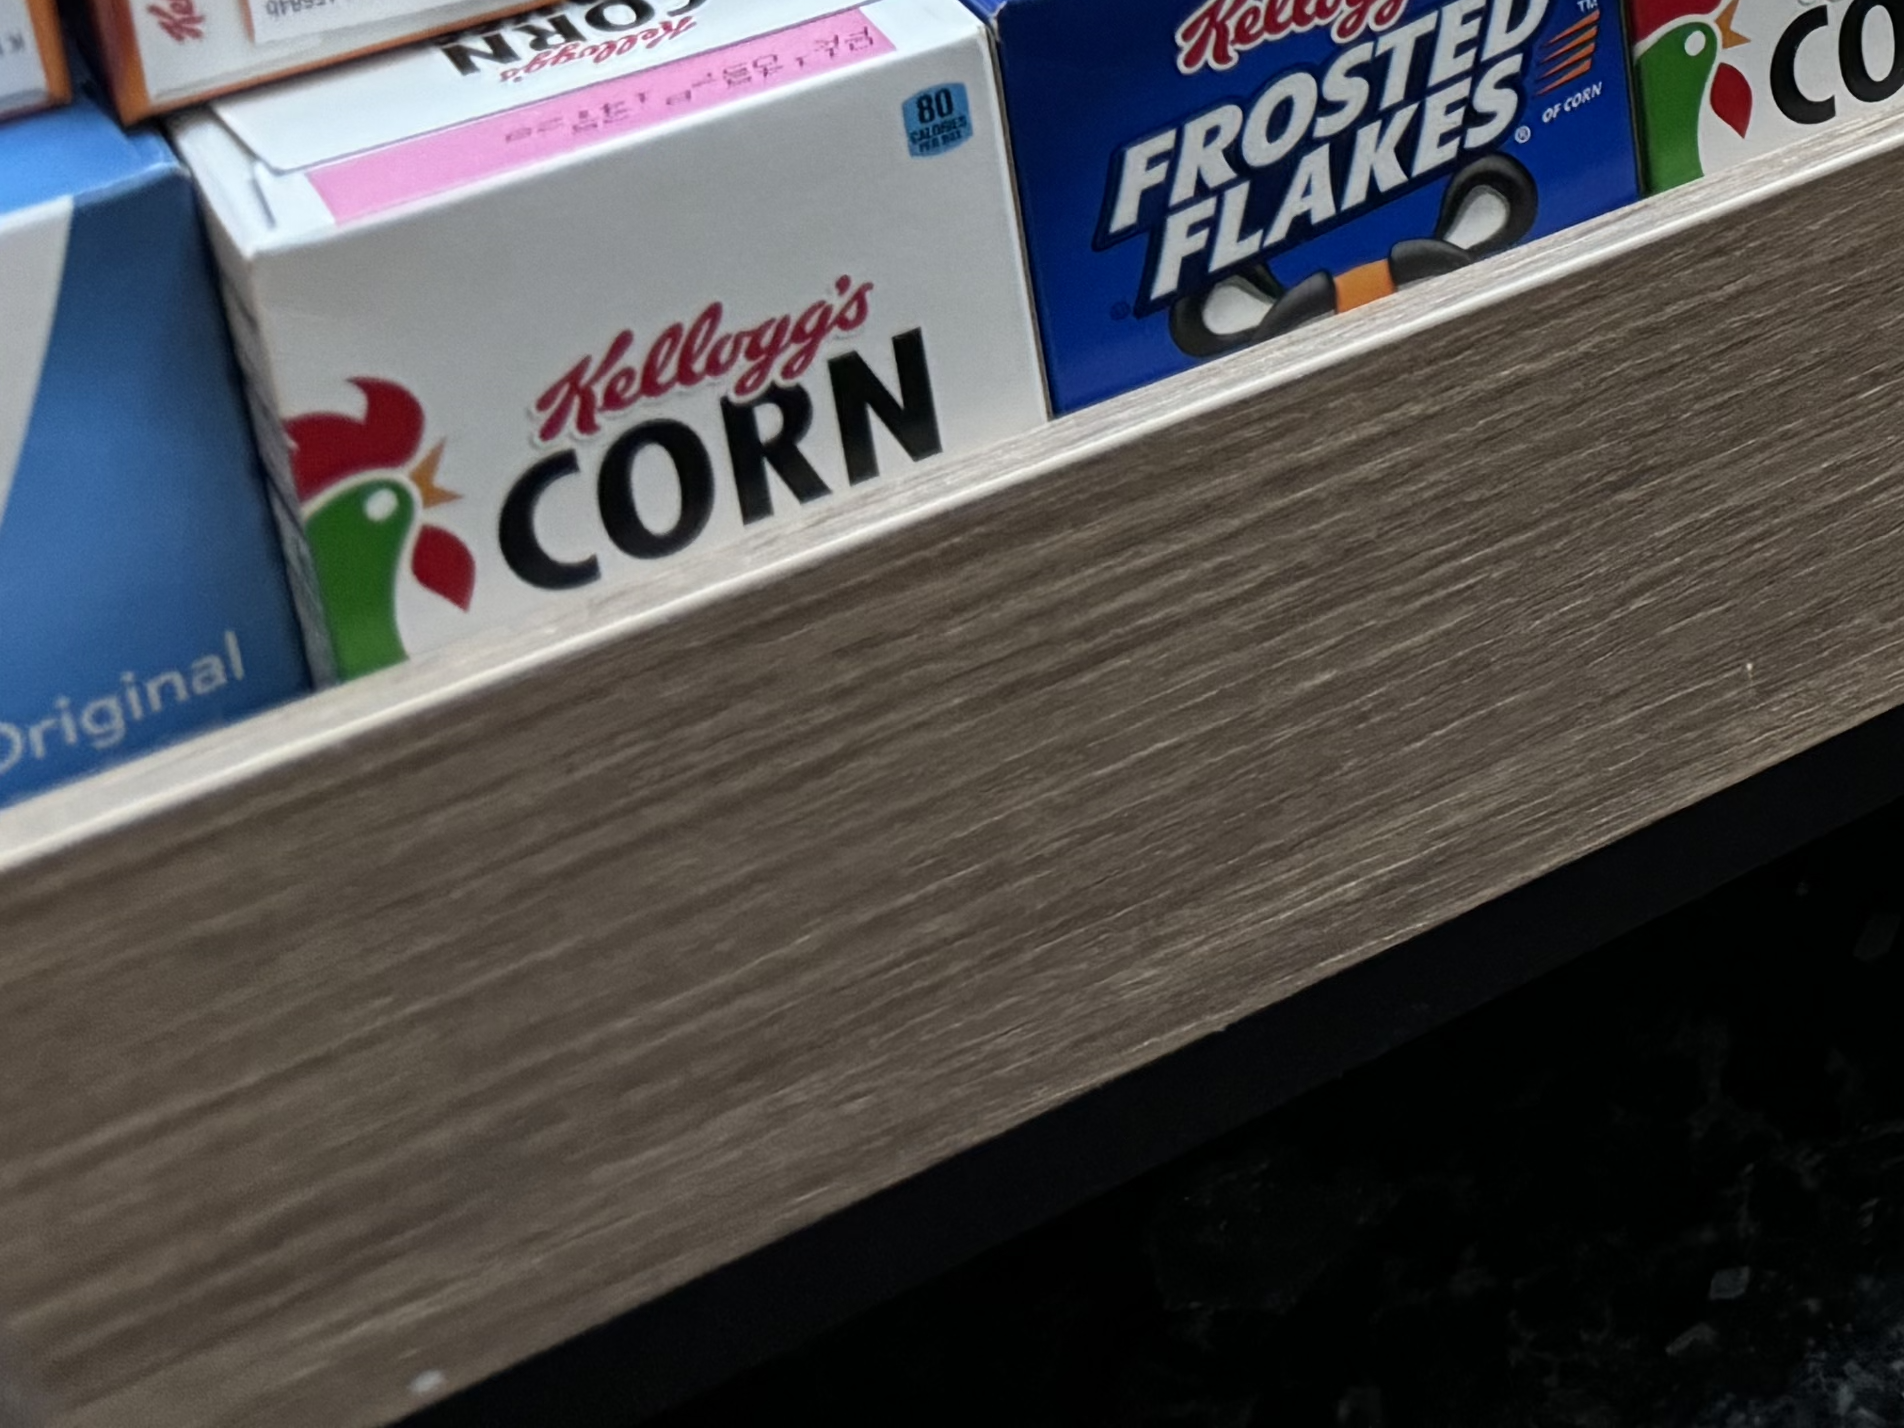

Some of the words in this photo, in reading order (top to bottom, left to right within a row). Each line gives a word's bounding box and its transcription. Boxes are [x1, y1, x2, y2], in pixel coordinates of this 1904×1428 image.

[915, 86, 955, 125] 80
[1148, 53, 1527, 304] FLAKES
[1542, 107, 1561, 124] OF
[1562, 82, 1603, 116] CORN
[534, 274, 874, 444] Kellogg's
[498, 326, 945, 592] CORN
